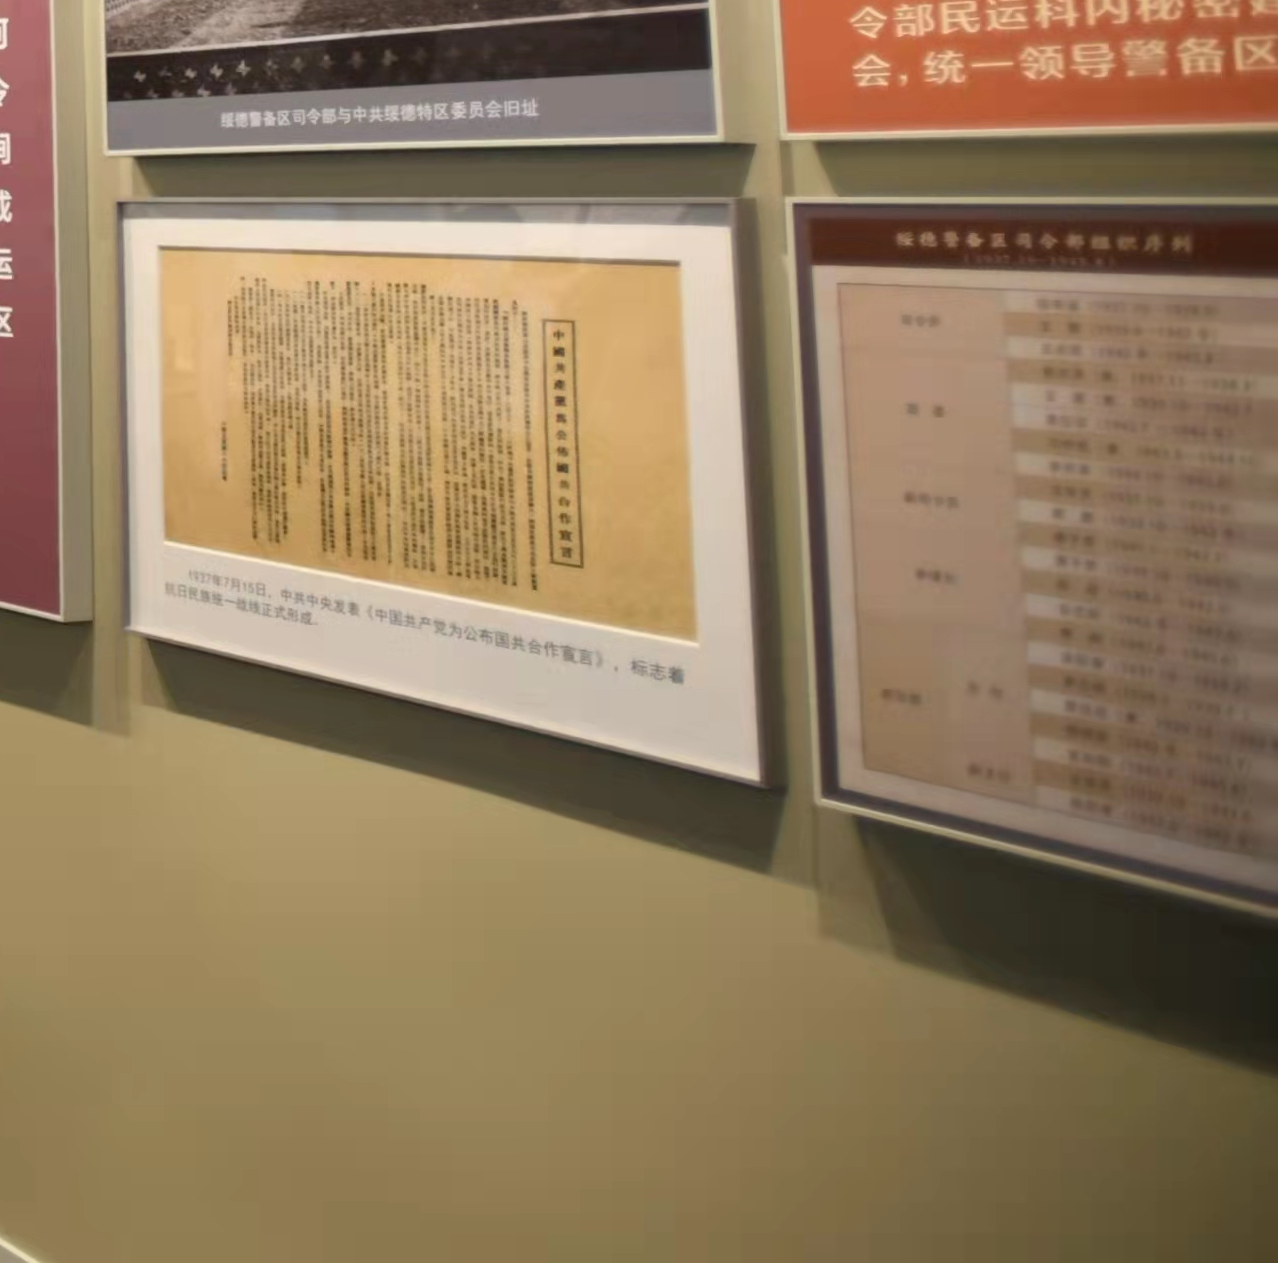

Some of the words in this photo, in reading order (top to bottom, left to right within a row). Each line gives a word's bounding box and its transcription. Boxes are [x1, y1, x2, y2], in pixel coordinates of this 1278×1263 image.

[852, 35, 1278, 88] 会，统一领导警备区
